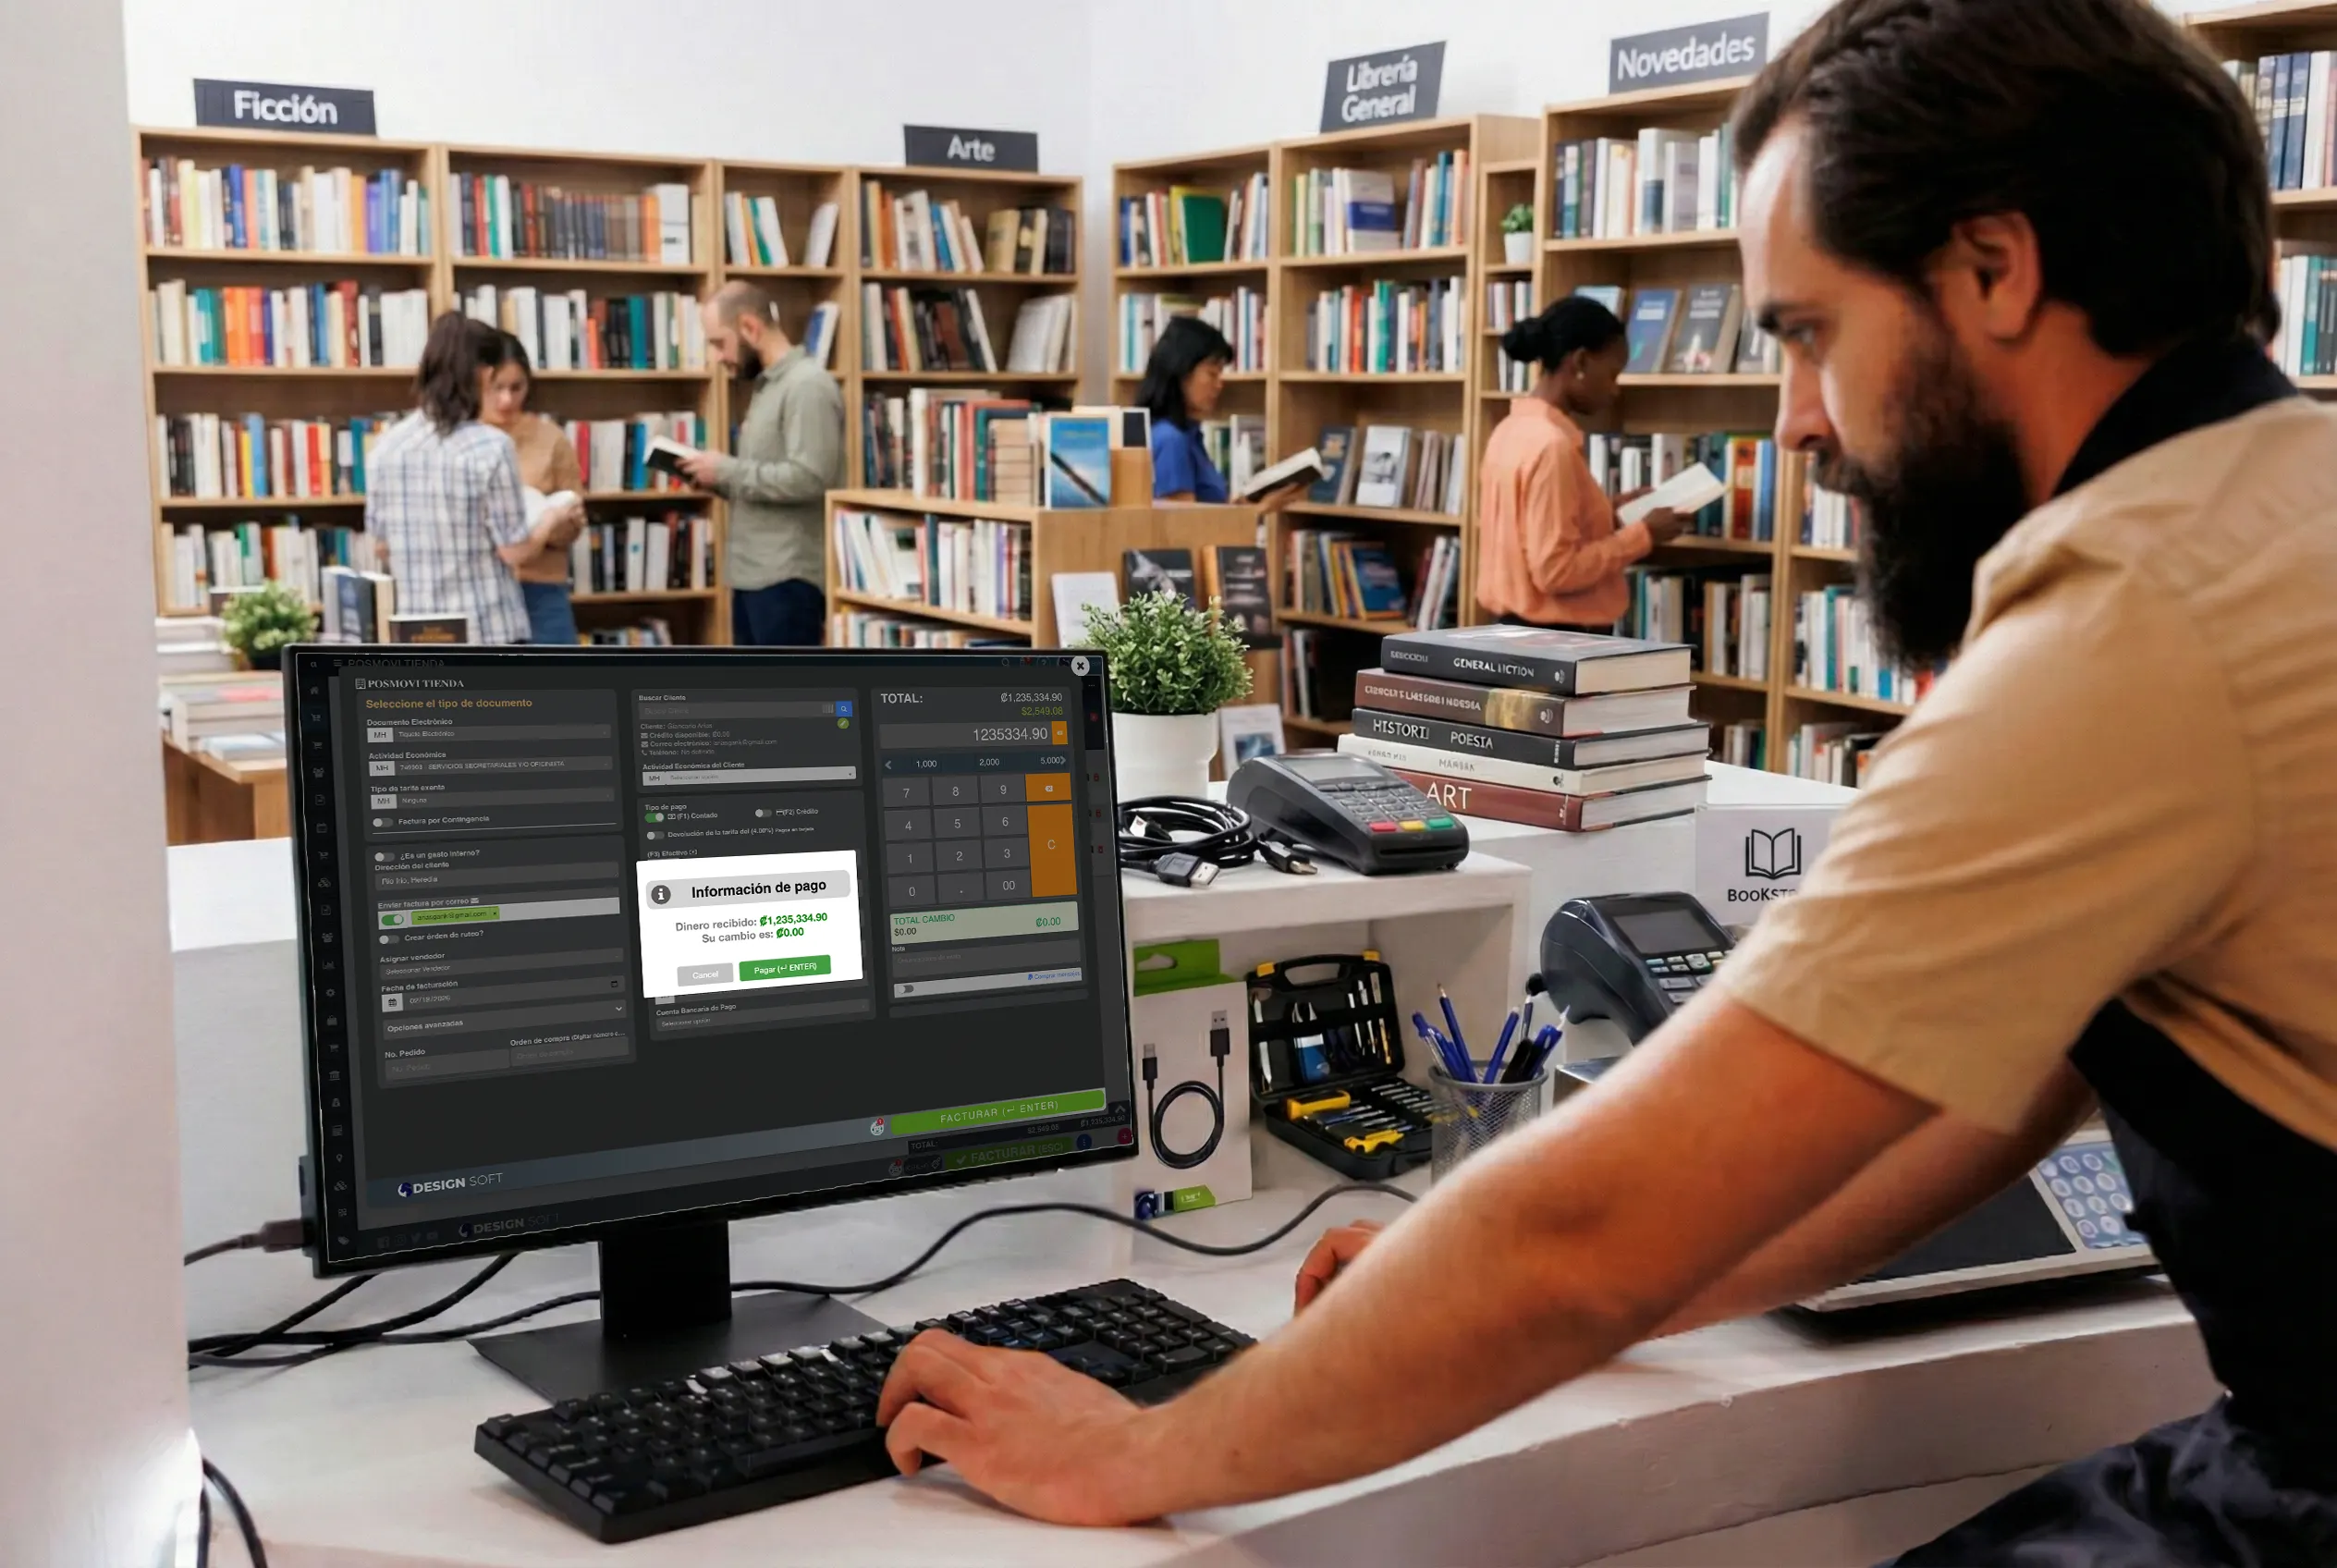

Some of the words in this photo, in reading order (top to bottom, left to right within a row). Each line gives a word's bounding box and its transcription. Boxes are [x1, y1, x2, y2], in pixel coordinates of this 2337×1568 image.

[1617, 32, 1756, 80] Novedades
[1346, 54, 1417, 92] Librería
[234, 90, 338, 125] Ficción
[1341, 85, 1415, 123] General
[947, 133, 996, 162] Arte
[1453, 657, 1496, 672] GENERAL
[368, 680, 421, 689] POSMOVI
[422, 680, 464, 688] TIENDA
[366, 699, 424, 709] Seleccione
[427, 699, 435, 708] el
[437, 699, 459, 710] tipo
[461, 698, 473, 708] de
[475, 698, 532, 708] documento
[881, 693, 924, 704] TOTAL:
[1021, 706, 1063, 717] $2,549.08
[973, 728, 1048, 741] 1235334.90
[1450, 730, 1494, 751] POESIA
[405, 751, 447, 759] Económica
[915, 759, 937, 769] 1,000
[979, 757, 1000, 767] 2,000
[1040, 755, 1060, 766] 5,000
[902, 788, 910, 798] 7
[952, 786, 960, 796] 8
[1000, 785, 1007, 795] 9
[1426, 781, 1473, 811] ART
[377, 797, 390, 805] MH
[905, 820, 912, 830] 4
[954, 819, 961, 828] 5
[1002, 816, 1009, 827] 6
[1047, 839, 1056, 850] C
[427, 851, 447, 860] gasto
[908, 853, 912, 864] 1
[956, 851, 963, 861] 2
[1004, 849, 1010, 859] 3
[375, 863, 410, 872] Dirección
[691, 882, 772, 899] Información
[775, 881, 791, 893] de
[794, 880, 827, 895] pago
[909, 886, 916, 897] 0
[1002, 880, 1015, 891] 00
[1728, 888, 1795, 902] BOOKST
[378, 901, 402, 910] Enviar
[403, 900, 430, 908] factura
[431, 900, 445, 908] por
[676, 921, 710, 932] Dinero
[713, 917, 757, 929] recibido:
[894, 915, 920, 925] TOTAL
[922, 913, 955, 925] CAMBIO
[404, 934, 426, 942] Crear
[702, 934, 716, 943] Su
[718, 931, 756, 942] cambio
[759, 930, 774, 939] es:
[894, 926, 917, 937] $0.00
[380, 956, 409, 964] Asignar
[411, 953, 446, 962] vendedor
[691, 971, 719, 980] Cancel
[753, 965, 776, 976] Pagar
[789, 962, 817, 973] ENTER)
[655, 1009, 679, 1017] Cuenta
[720, 1004, 737, 1012] Pago
[387, 1023, 423, 1034] Opciones
[424, 1020, 464, 1030] avanzadas
[510, 1038, 532, 1047] Orden
[385, 1050, 398, 1059] No.
[399, 1048, 426, 1058] Pedido
[940, 1108, 997, 1123] FACTURAR
[1020, 1100, 1058, 1115] ENTER)
[911, 1139, 938, 1150] TOTAL:
[972, 1145, 1035, 1163] FACTURAR
[412, 1177, 466, 1194] DESIGN
[469, 1172, 504, 1188] SOFT
[473, 1217, 524, 1234] DESIGN
